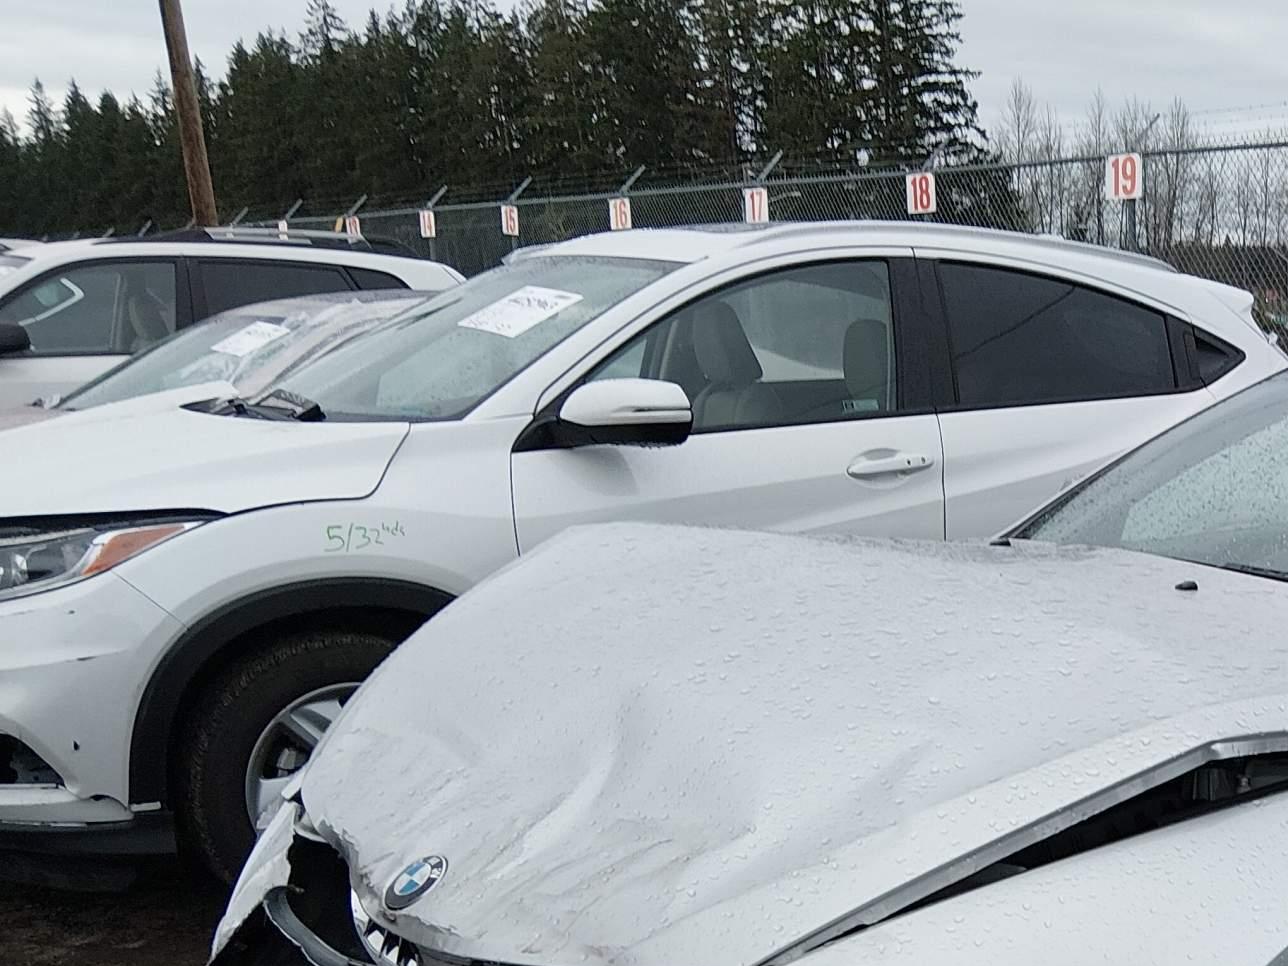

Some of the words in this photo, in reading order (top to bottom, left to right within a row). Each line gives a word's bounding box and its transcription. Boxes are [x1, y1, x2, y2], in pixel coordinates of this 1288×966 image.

[1111, 157, 1137, 196] 19
[750, 191, 763, 221] 17
[910, 175, 931, 211] 18
[504, 208, 516, 234] 15
[614, 201, 628, 227] 16
